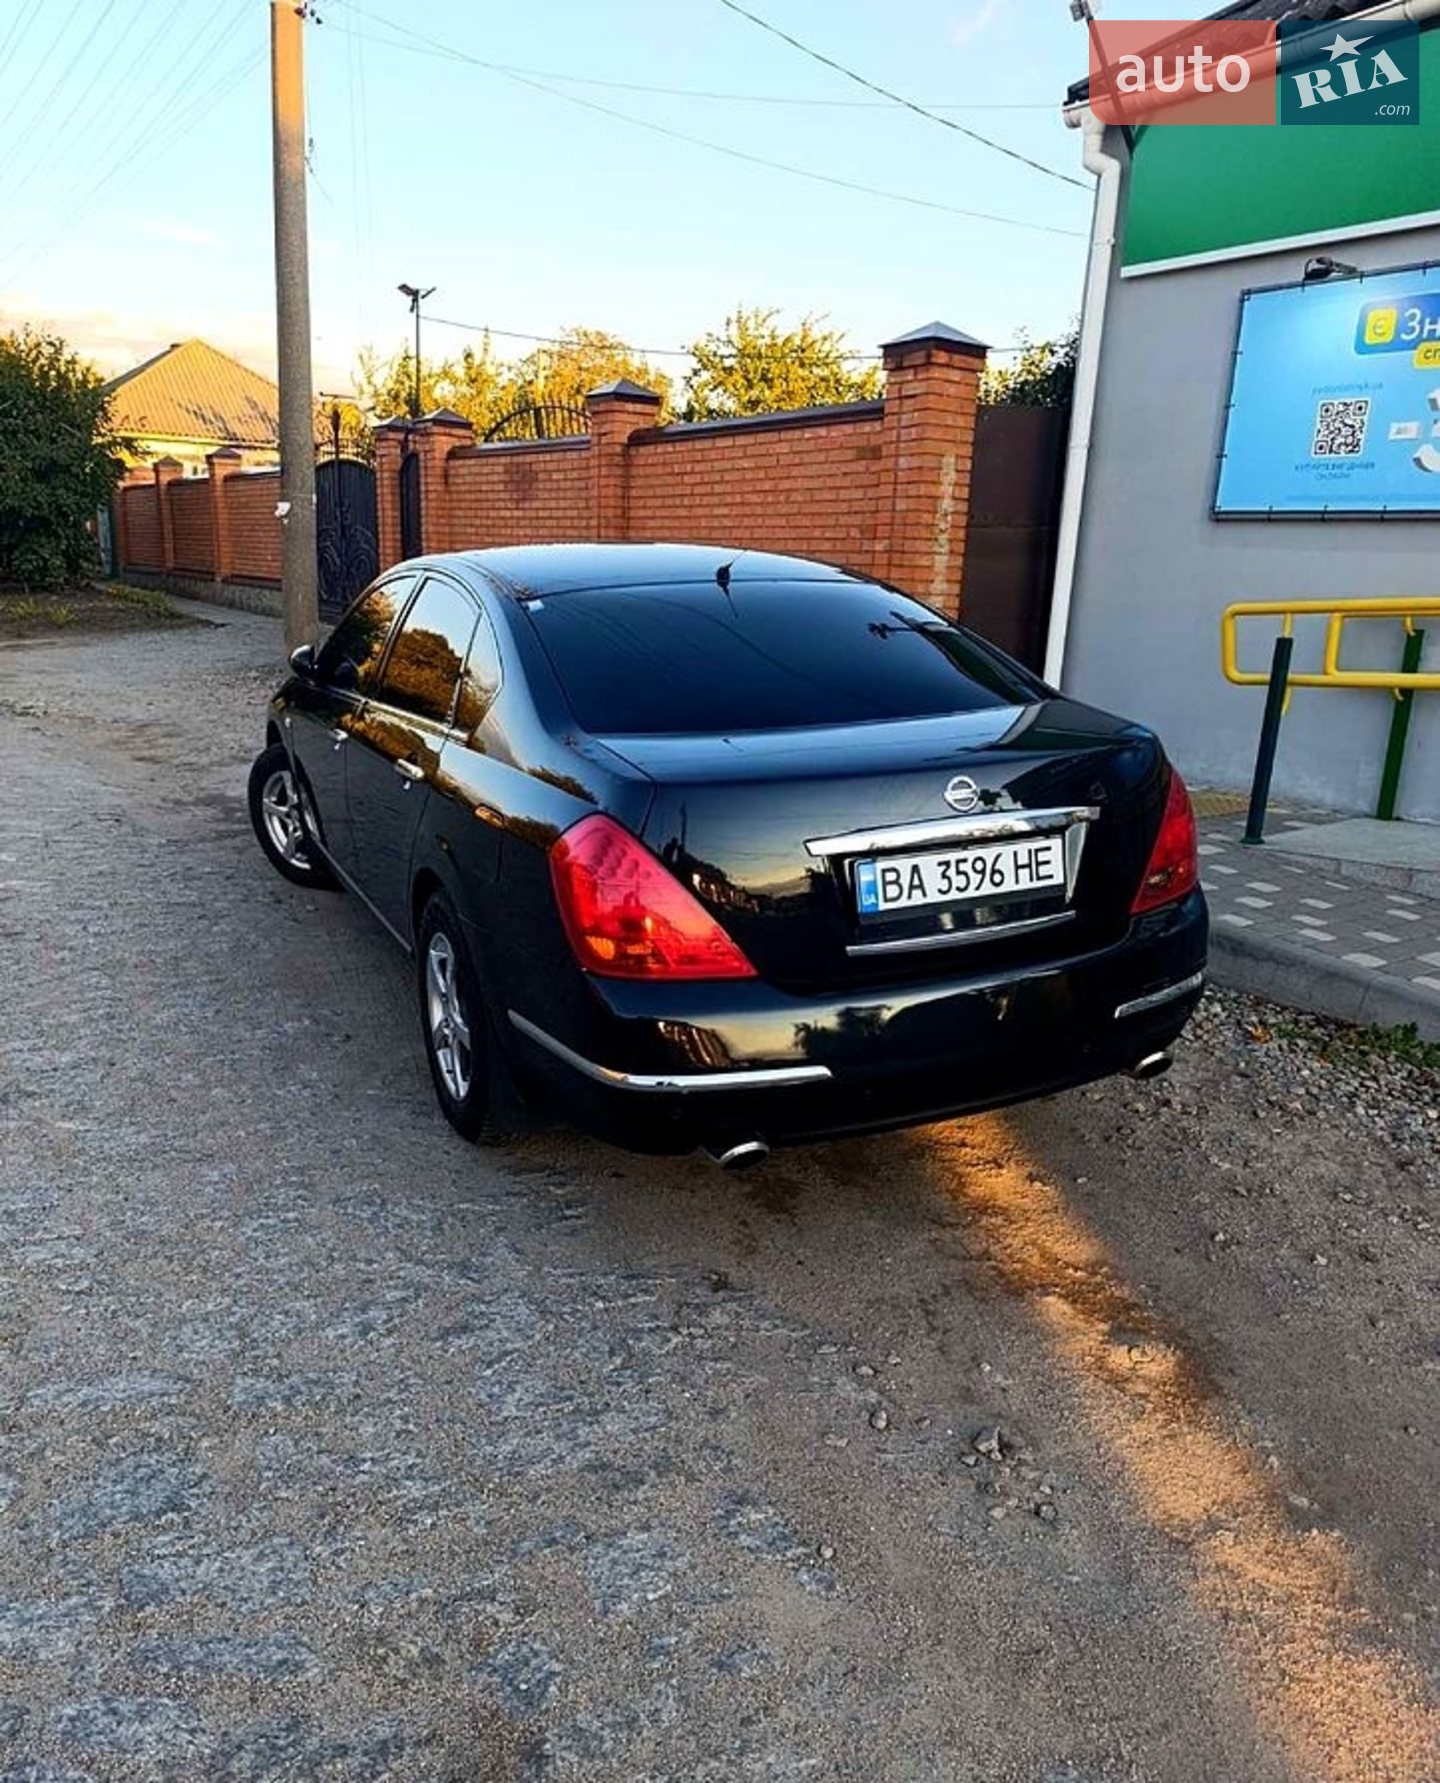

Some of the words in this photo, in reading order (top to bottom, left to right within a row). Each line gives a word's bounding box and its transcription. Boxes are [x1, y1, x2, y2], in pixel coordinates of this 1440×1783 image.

[881, 863, 928, 903] BA
[937, 852, 1005, 896] 3596
[1013, 845, 1055, 885] HE
